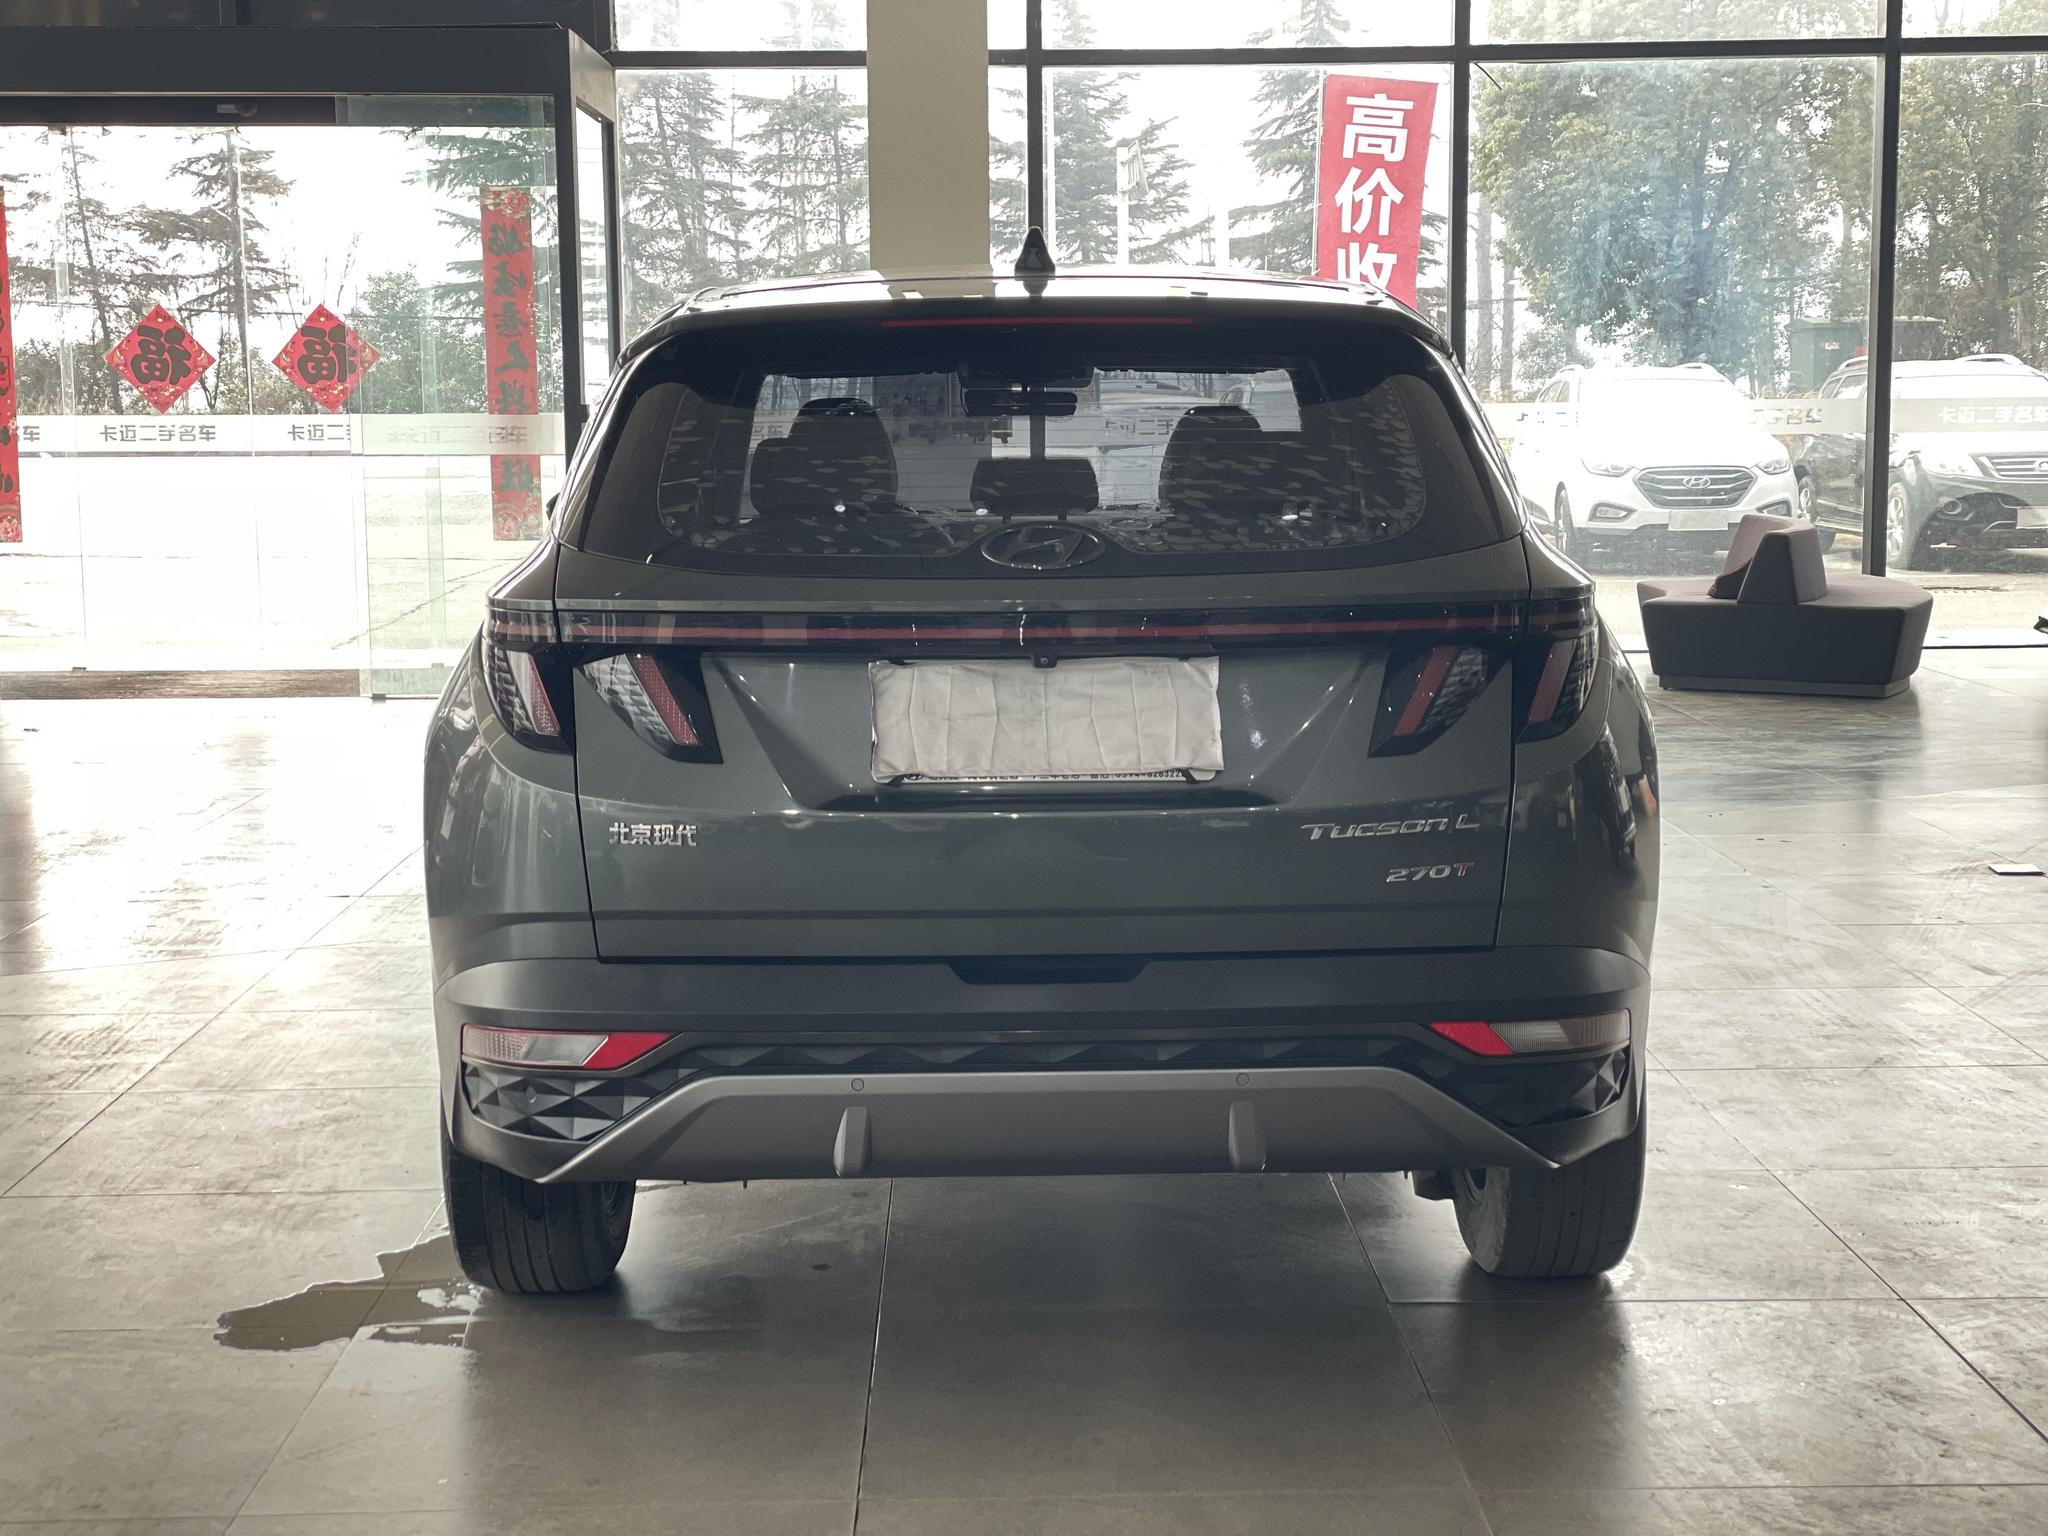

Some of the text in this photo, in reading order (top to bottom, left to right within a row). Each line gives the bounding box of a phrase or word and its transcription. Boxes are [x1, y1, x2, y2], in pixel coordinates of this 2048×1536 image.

[1335, 93, 1414, 290] 高价收
[99, 424, 216, 442] 卡迈二手名车
[287, 424, 350, 442] 卡迈二
[1455, 814, 1480, 830] L
[608, 822, 697, 847] 北京现代
